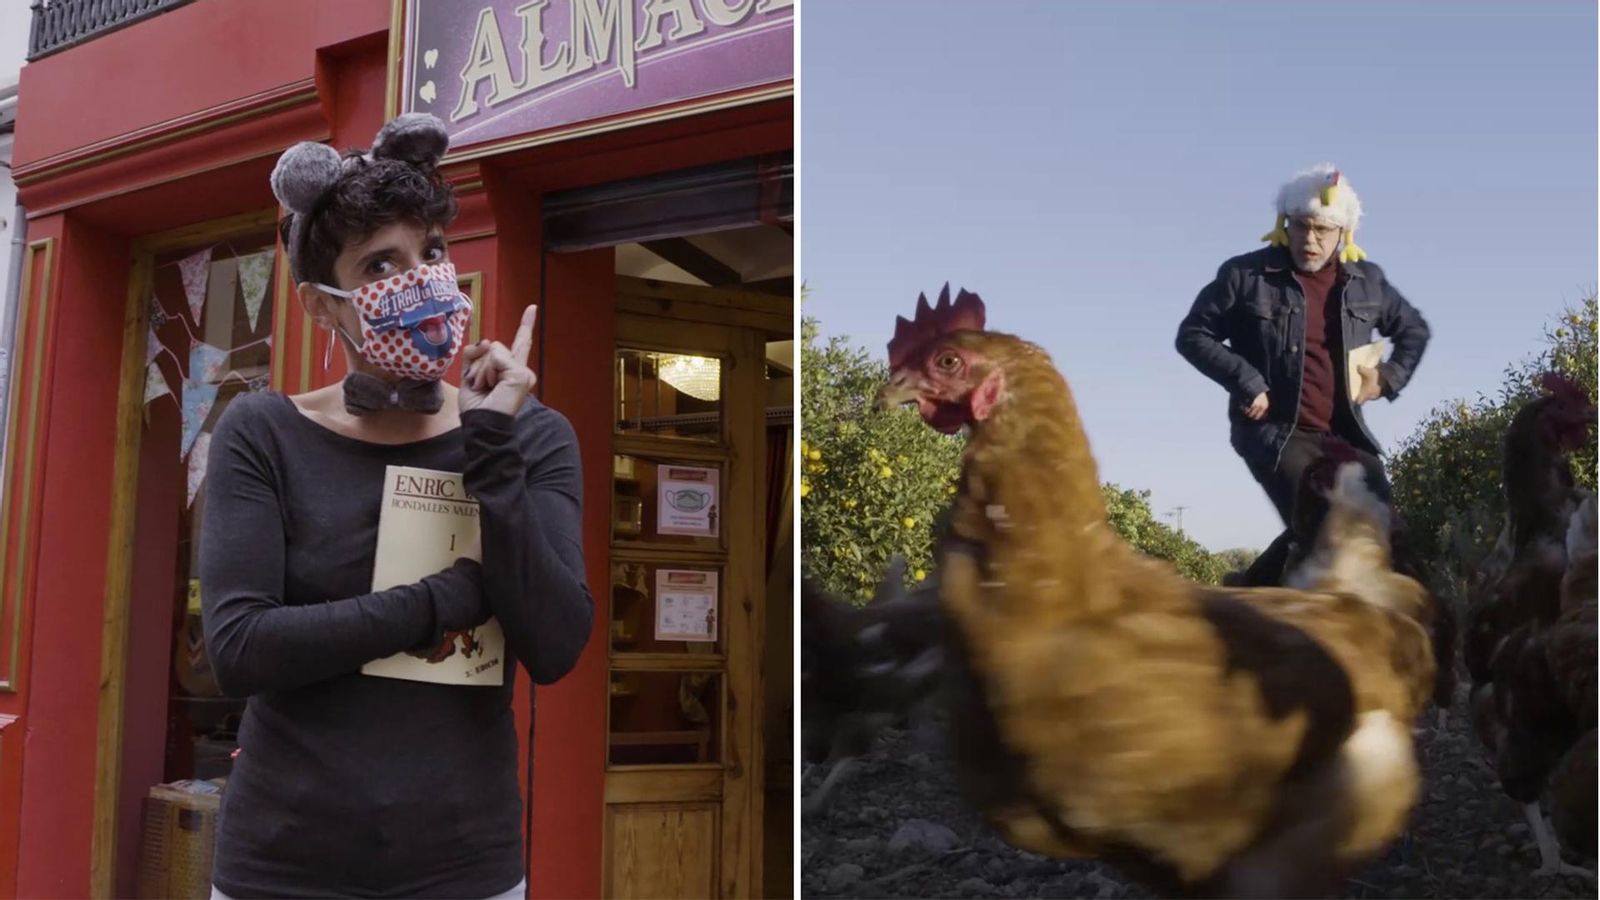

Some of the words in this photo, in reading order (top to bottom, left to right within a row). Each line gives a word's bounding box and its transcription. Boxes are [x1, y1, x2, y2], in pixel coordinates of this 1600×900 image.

[450, 0, 793, 122] ALMA
[381, 285, 421, 317] #TRAU
[395, 475, 456, 498] ENRIC
